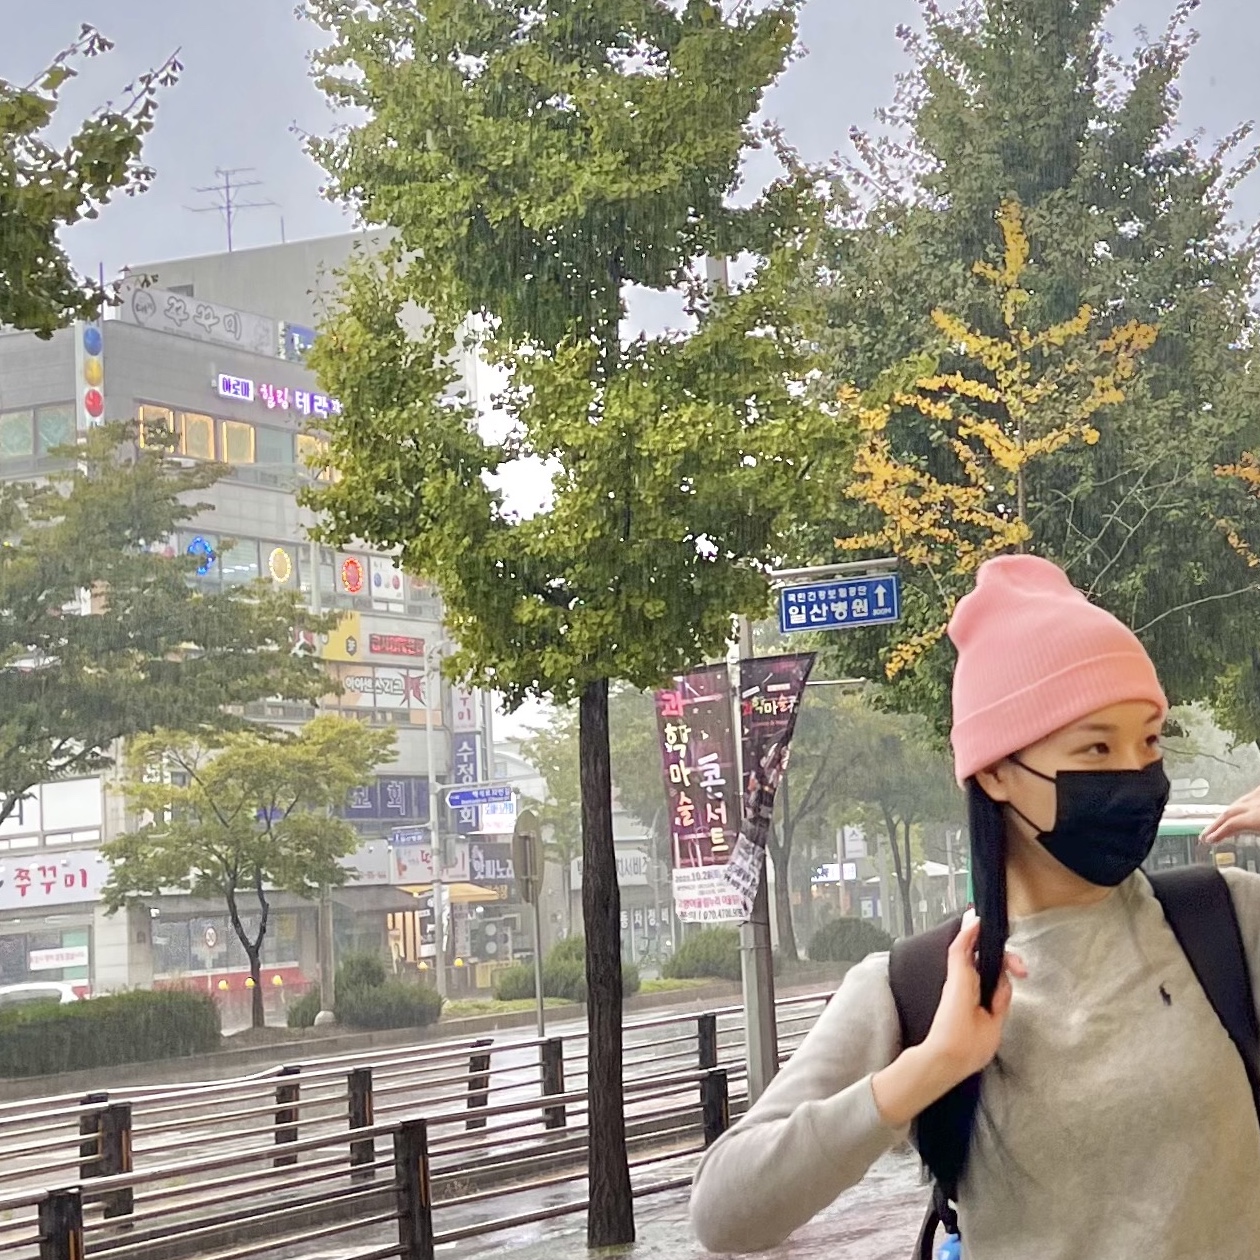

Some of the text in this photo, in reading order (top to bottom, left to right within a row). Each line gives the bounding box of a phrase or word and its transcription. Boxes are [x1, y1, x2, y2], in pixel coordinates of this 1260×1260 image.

[222, 377, 250, 398] 아로마
[260, 383, 289, 409] 힐링
[788, 598, 868, 624] 일산병원
[661, 690, 695, 827] 과학마술
[351, 781, 406, 815] 교회
[456, 741, 476, 827] 수정회
[699, 755, 729, 851] 콘서트
[14, 866, 88, 897] 쭈꾸미
